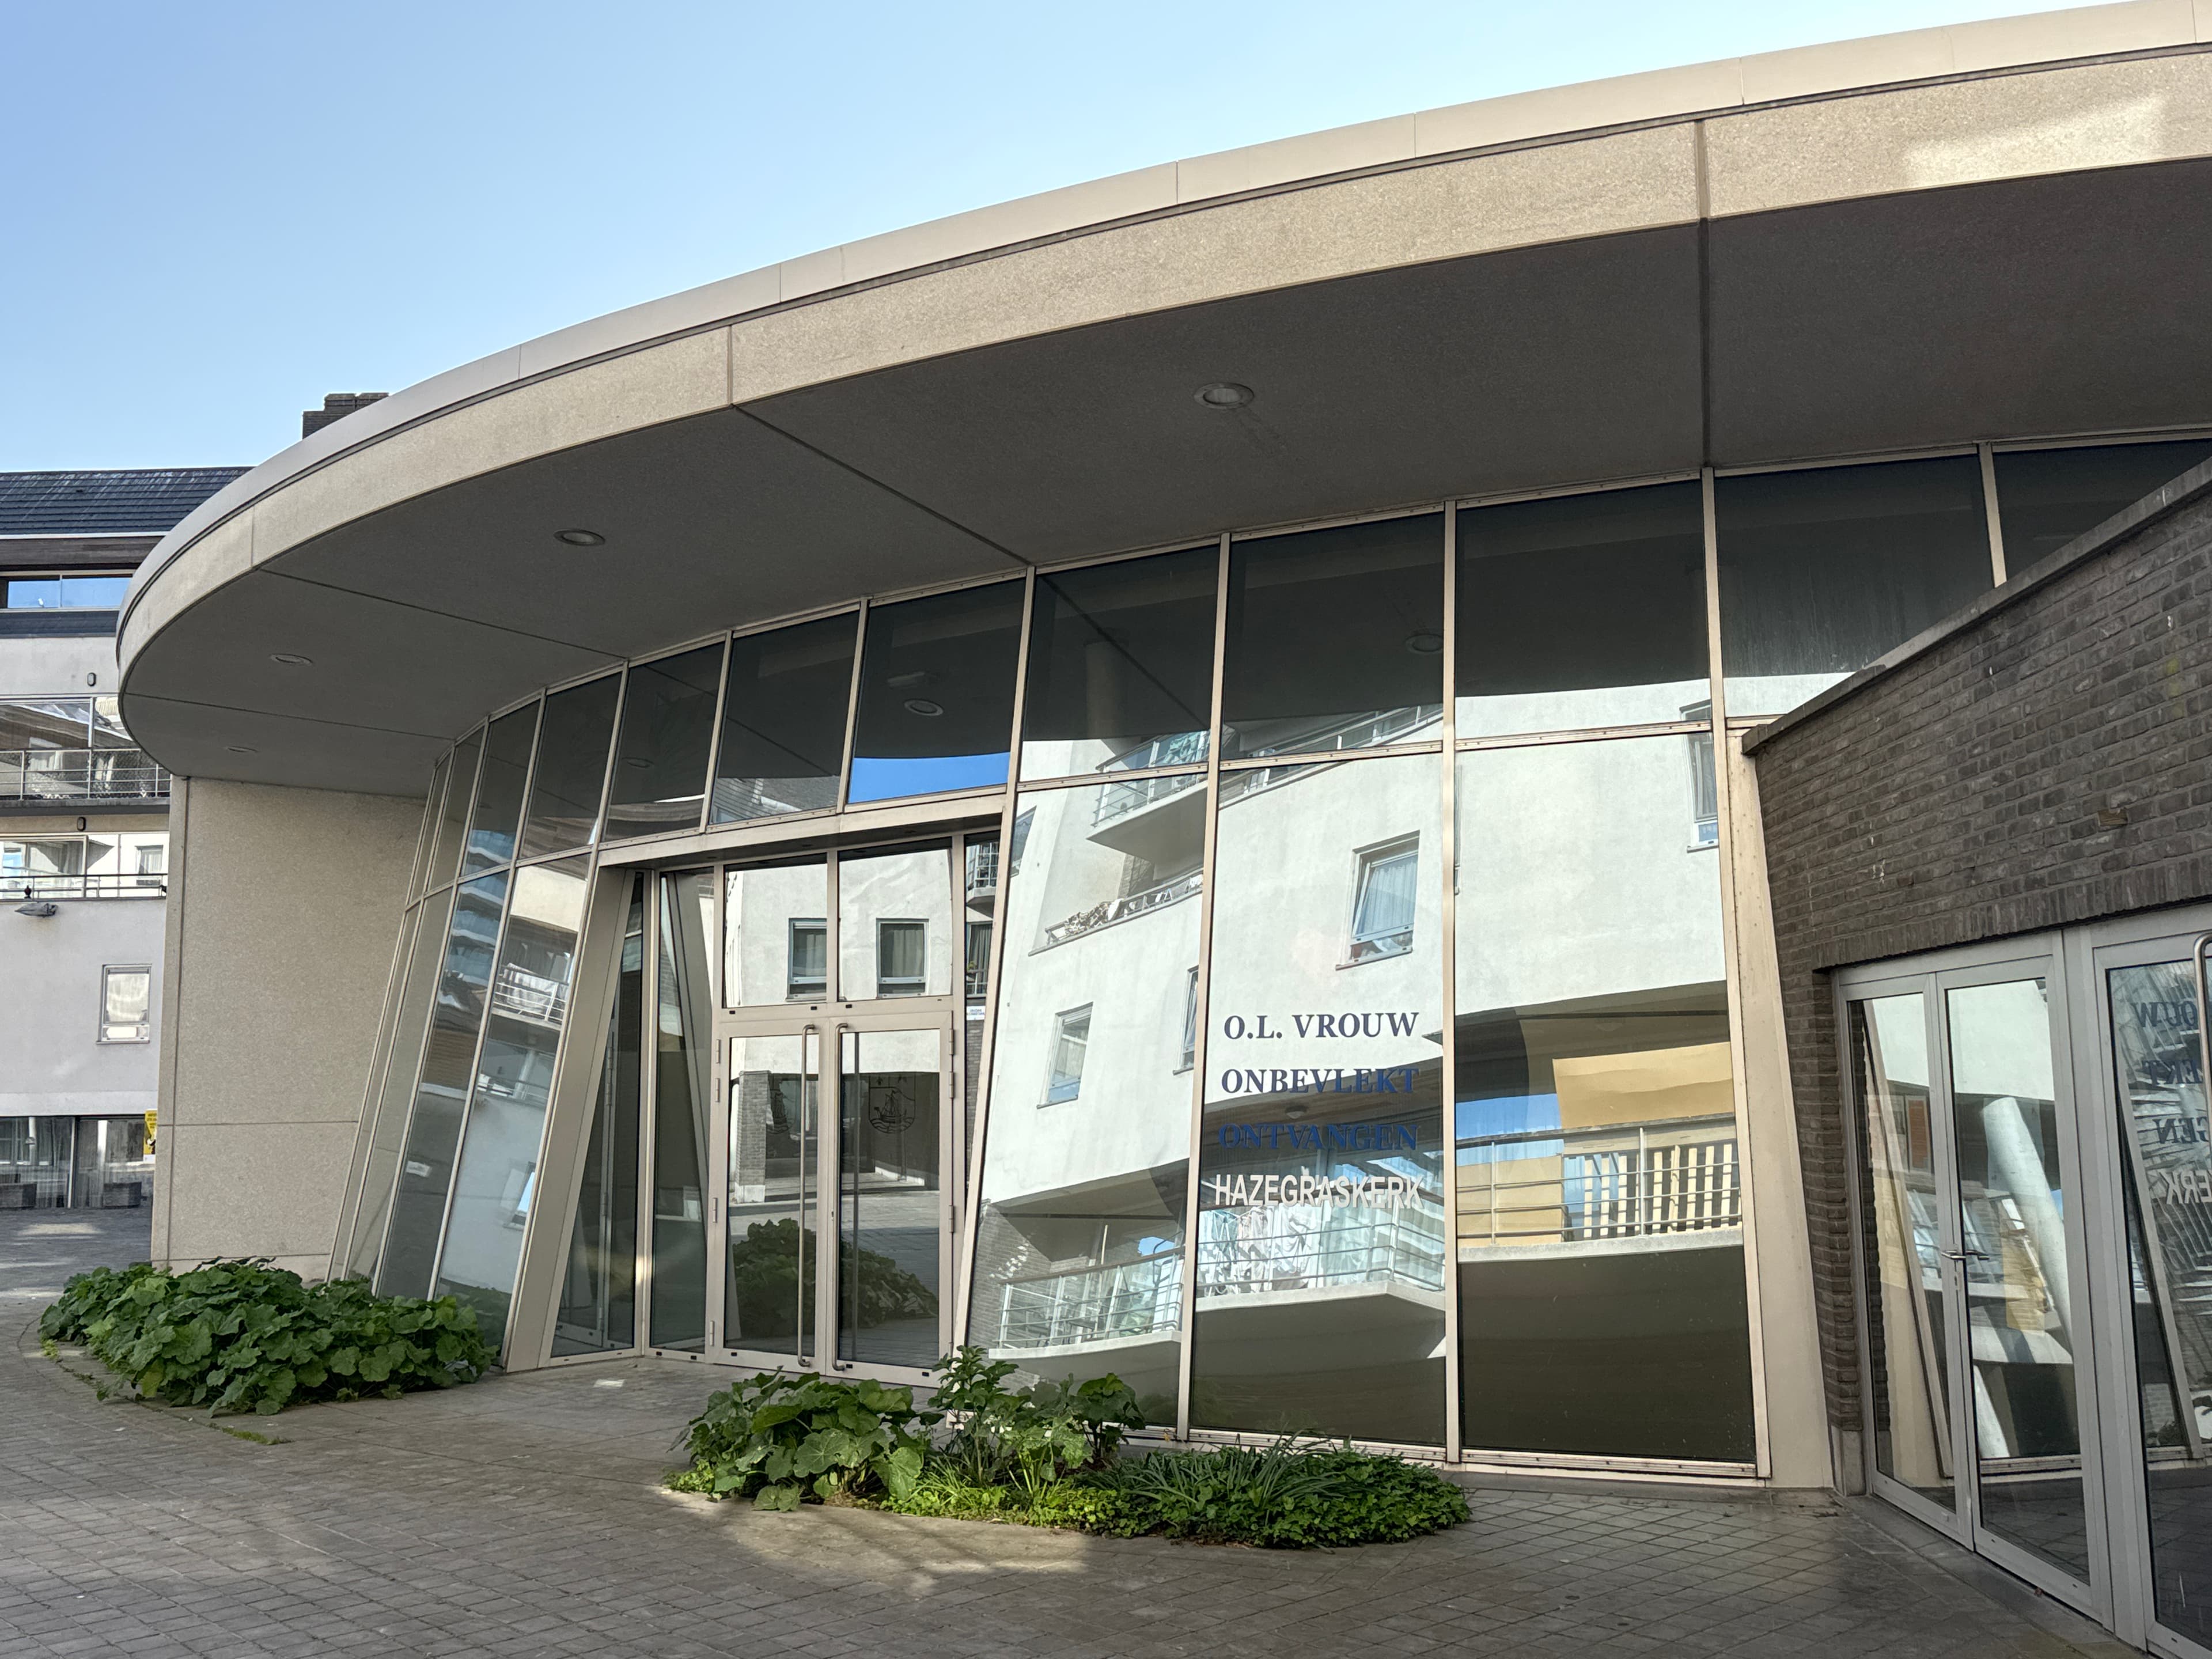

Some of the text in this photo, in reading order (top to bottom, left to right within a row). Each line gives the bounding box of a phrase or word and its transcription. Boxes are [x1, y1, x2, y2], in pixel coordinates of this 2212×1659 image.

[1224, 1012, 1420, 1039] O.L. VROUW
[1221, 1068, 1420, 1093] ONBEVLEKT
[1218, 1123, 1419, 1150] ONTVANGEN
[1215, 1173, 1425, 1209] HAZEGRASKERK
